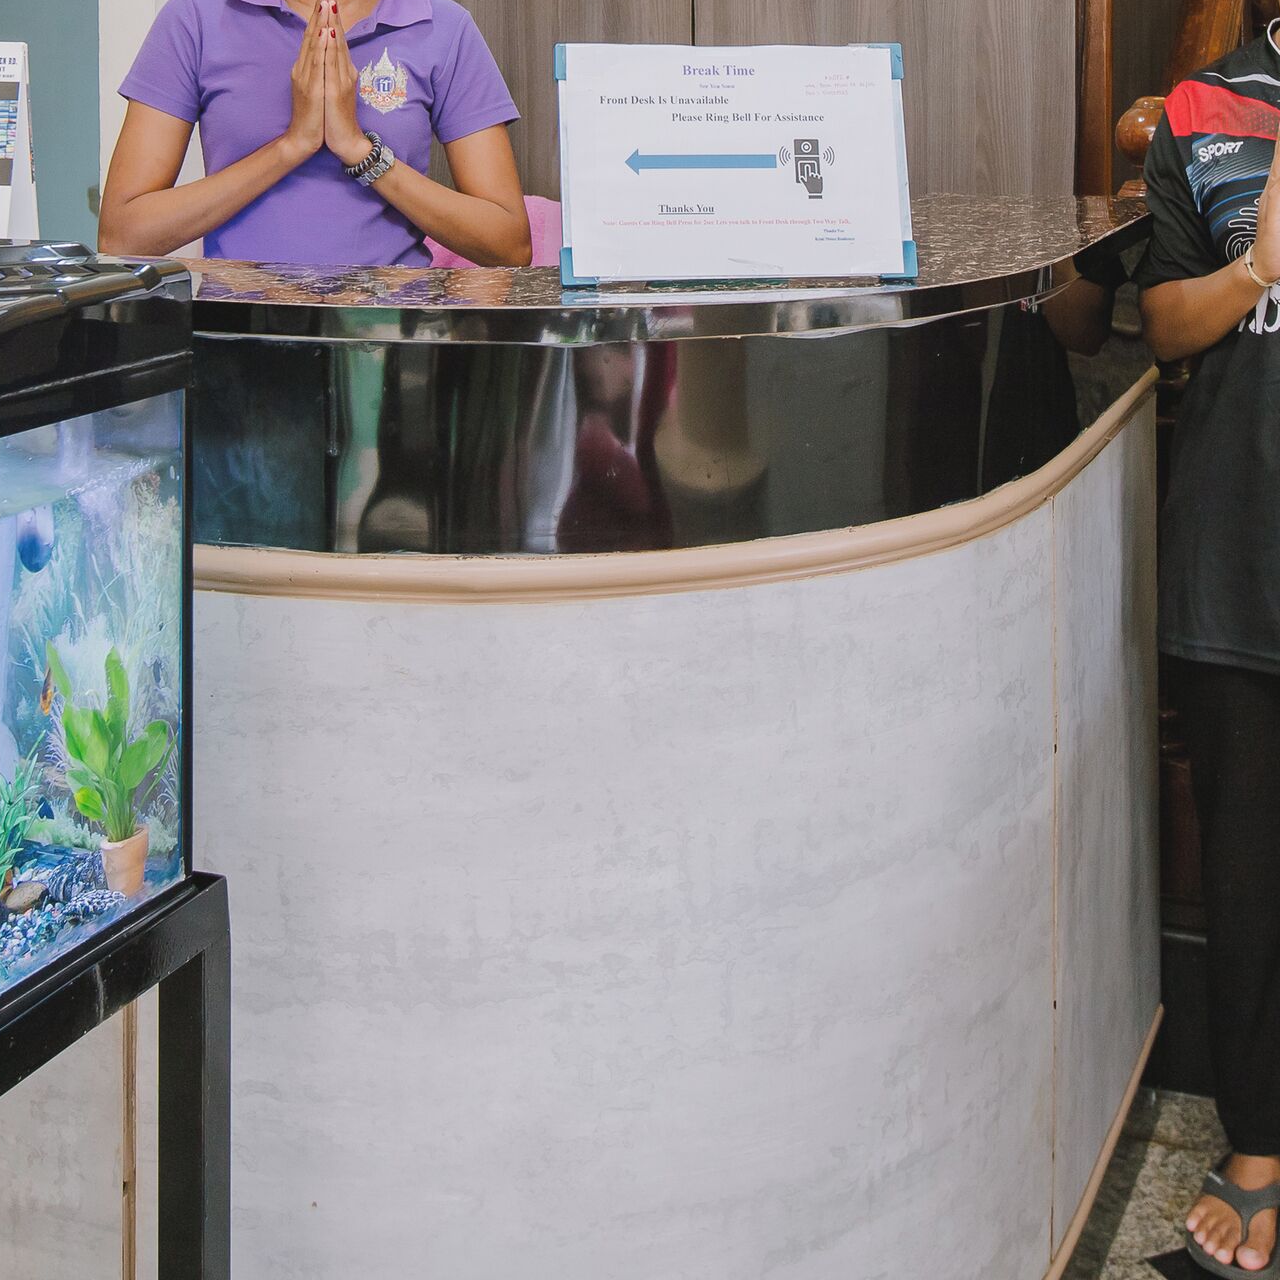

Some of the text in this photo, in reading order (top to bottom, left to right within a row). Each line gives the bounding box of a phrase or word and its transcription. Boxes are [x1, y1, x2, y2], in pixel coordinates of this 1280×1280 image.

[682, 64, 755, 77] Break Time
[599, 95, 730, 106] Front Desk Is Unavailable
[672, 112, 825, 125] Please Ring Bell For Assistance
[1198, 141, 1244, 163] SPORT
[659, 204, 714, 213] Thanks You
